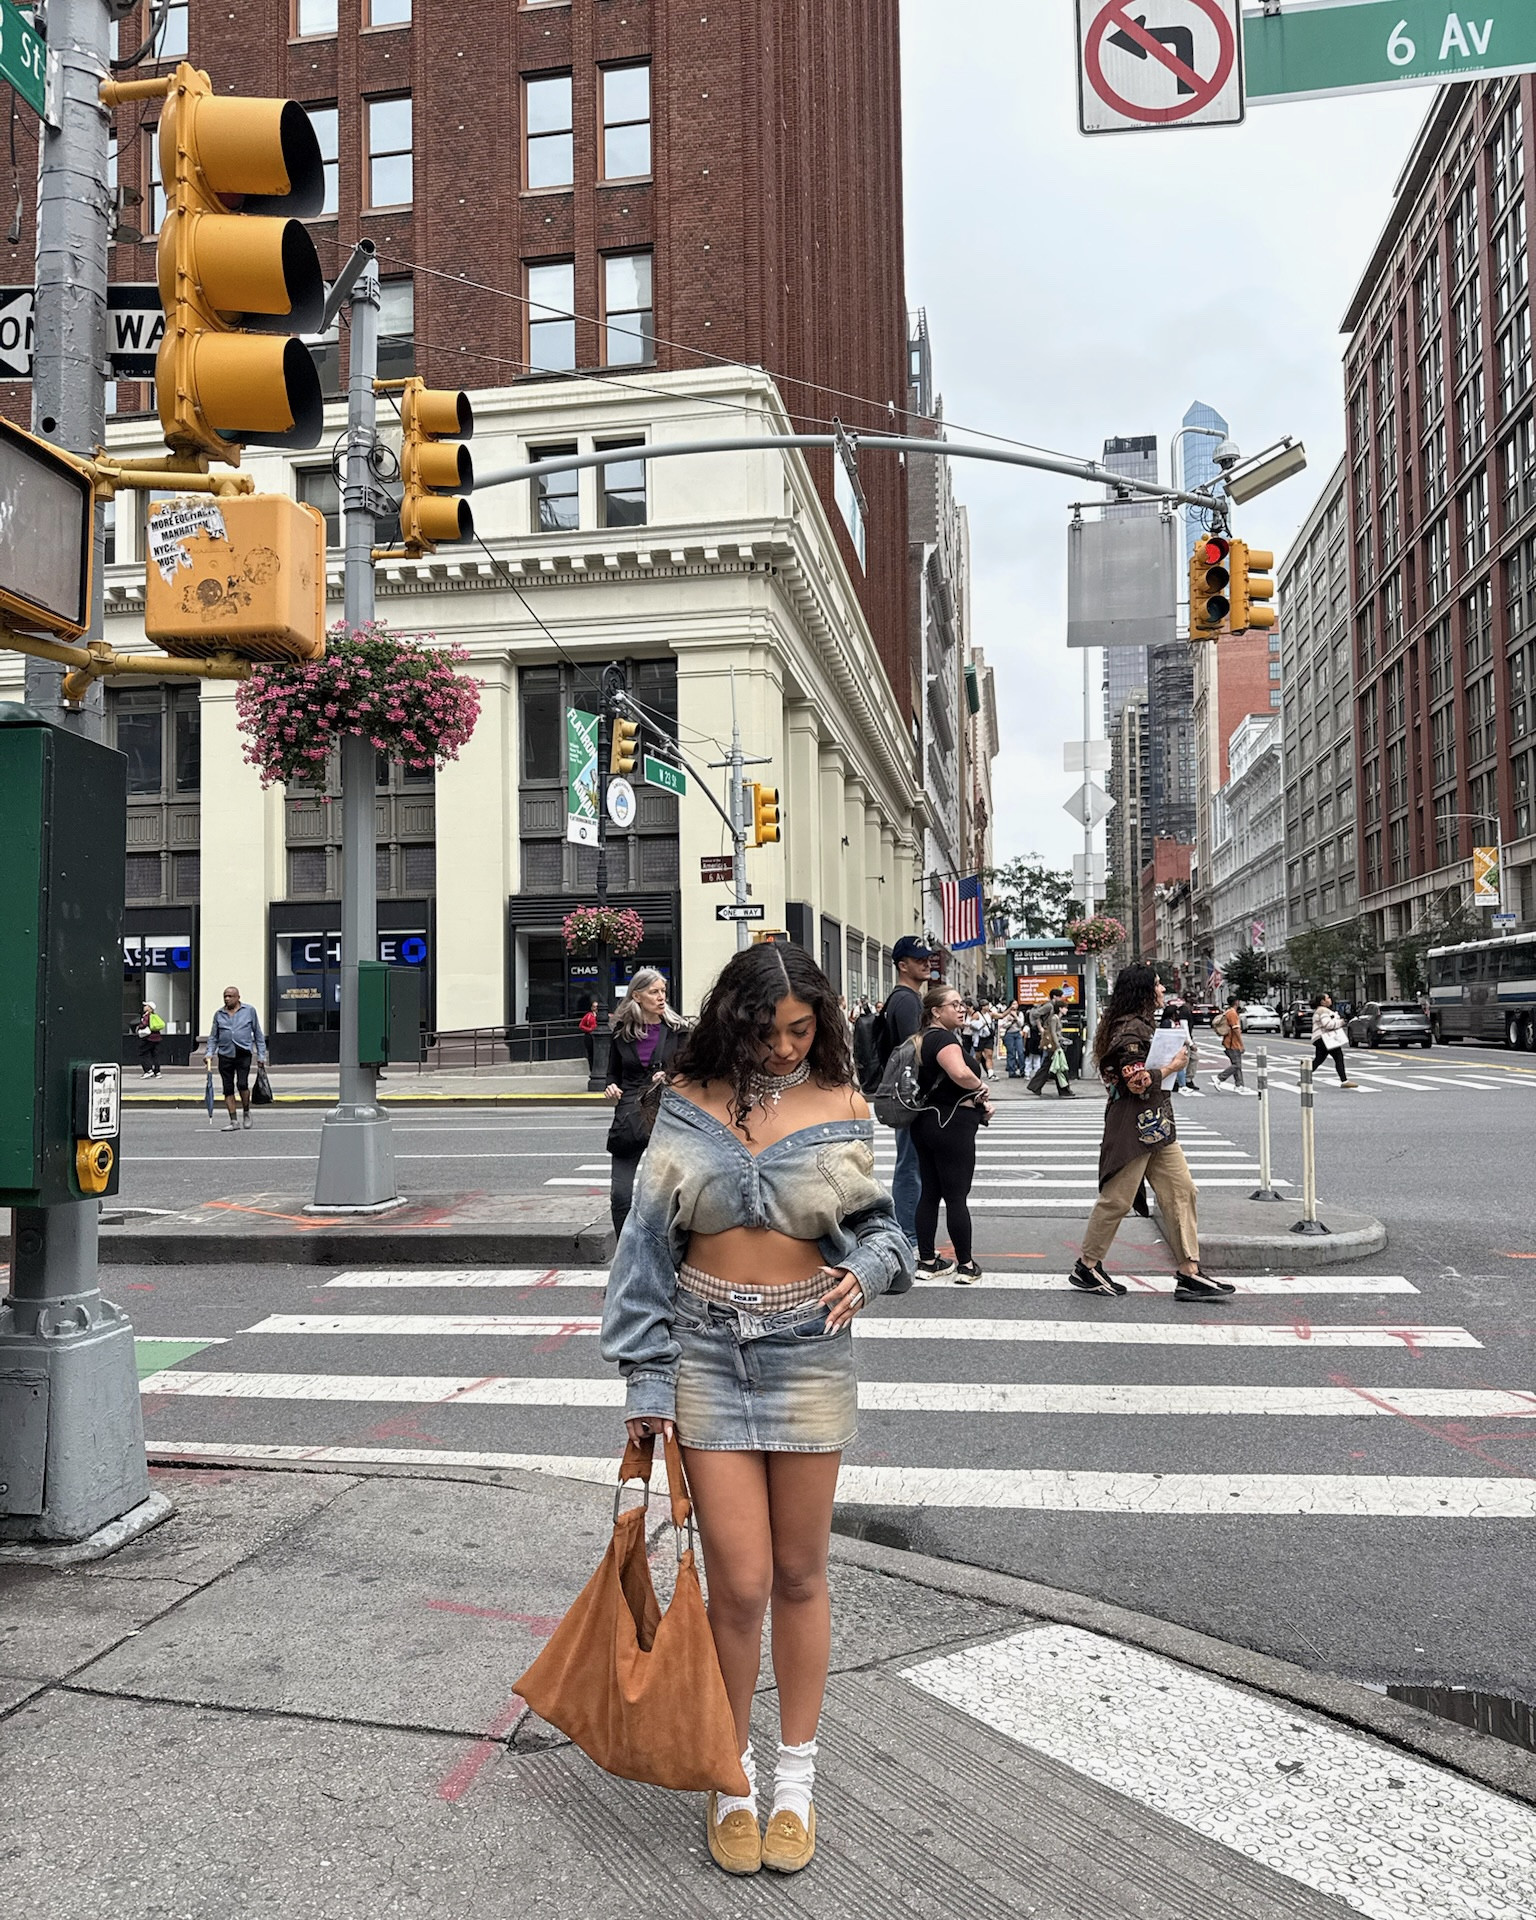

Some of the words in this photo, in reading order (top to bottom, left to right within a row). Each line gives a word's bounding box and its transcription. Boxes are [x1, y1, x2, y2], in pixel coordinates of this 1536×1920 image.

[1386, 19, 1416, 66] 6
[1438, 12, 1494, 60] Av
[21, 31, 40, 80] St
[1, 316, 34, 350] ON
[115, 314, 165, 350] WA
[151, 517, 174, 531] MORE
[665, 770, 671, 786] 23
[572, 778, 596, 818] NOMAD
[722, 909, 736, 917] ONE
[124, 948, 167, 967] ASE
[305, 941, 397, 963] CHE
[570, 966, 599, 975] CHAS
